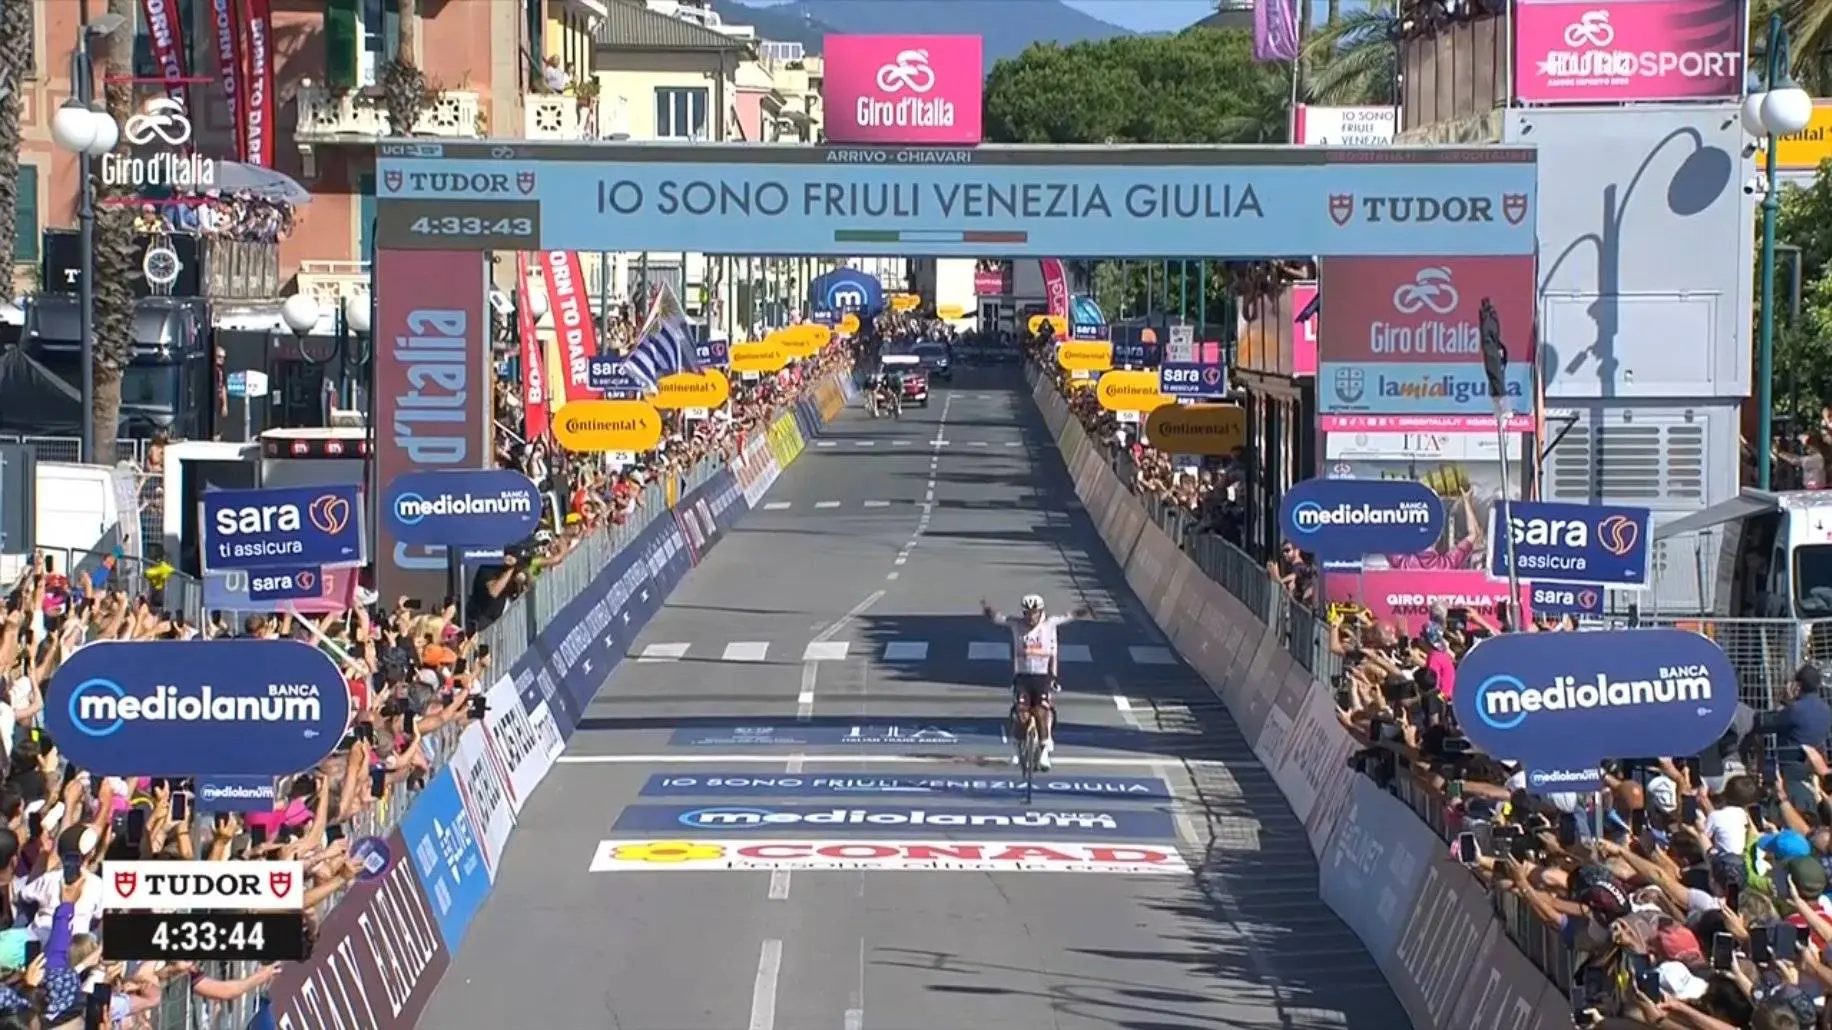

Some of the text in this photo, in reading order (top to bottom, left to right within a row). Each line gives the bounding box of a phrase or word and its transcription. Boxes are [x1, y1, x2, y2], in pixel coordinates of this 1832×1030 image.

[857, 95, 955, 127] Giro d'Italia
[1341, 111, 1394, 121] IO SONO
[1341, 135, 1389, 145] VENEZIA
[382, 145, 405, 155] UCI
[826, 150, 886, 163] ARRIVO
[896, 150, 972, 163] CHIAVARI
[409, 172, 510, 194] TUDOR
[598, 180, 1264, 219] IO SONO FRIULI VENEZIA GIULIA
[1363, 197, 1494, 222] TUDOR
[410, 216, 533, 236] 4:33:43
[835, 291, 861, 308] m
[550, 250, 589, 386] ORN TO DARE
[1076, 325, 1097, 335] sara
[1371, 320, 1481, 354] Giro d'Italia
[1163, 368, 1200, 382] sara
[392, 310, 467, 464] d'Italia
[658, 382, 709, 394] ontinental
[1105, 383, 1159, 397] Continenta
[1378, 374, 1523, 402] lamialigua
[566, 418, 636, 434] Continental
[1159, 421, 1230, 437] Continental
[615, 452, 628, 461] 25
[500, 490, 530, 499] BANCA
[400, 494, 531, 516] mediolanum
[1400, 501, 1428, 510] BANCA
[216, 503, 301, 535] sara
[1298, 503, 1430, 526] mediolanum
[1509, 518, 1588, 548] sara
[219, 539, 303, 558] ti assicura
[1517, 553, 1587, 571] assicura
[251, 573, 293, 592] sara
[1386, 593, 1424, 606] GIRO
[1533, 589, 1574, 606] sara
[1659, 665, 1708, 680] BANCA
[269, 684, 320, 697] BANCA
[1485, 672, 1712, 715] mediolanum
[79, 685, 321, 722] mediolanum
[662, 777, 1149, 792] IO SONO FRIULI VENEZIA GIULIA
[1532, 769, 1599, 785] mediolanum
[203, 786, 274, 799] mediolanum
[699, 809, 1117, 829] mediolanum
[737, 844, 1168, 862] CONAD
[357, 856, 438, 1019] EATALY
